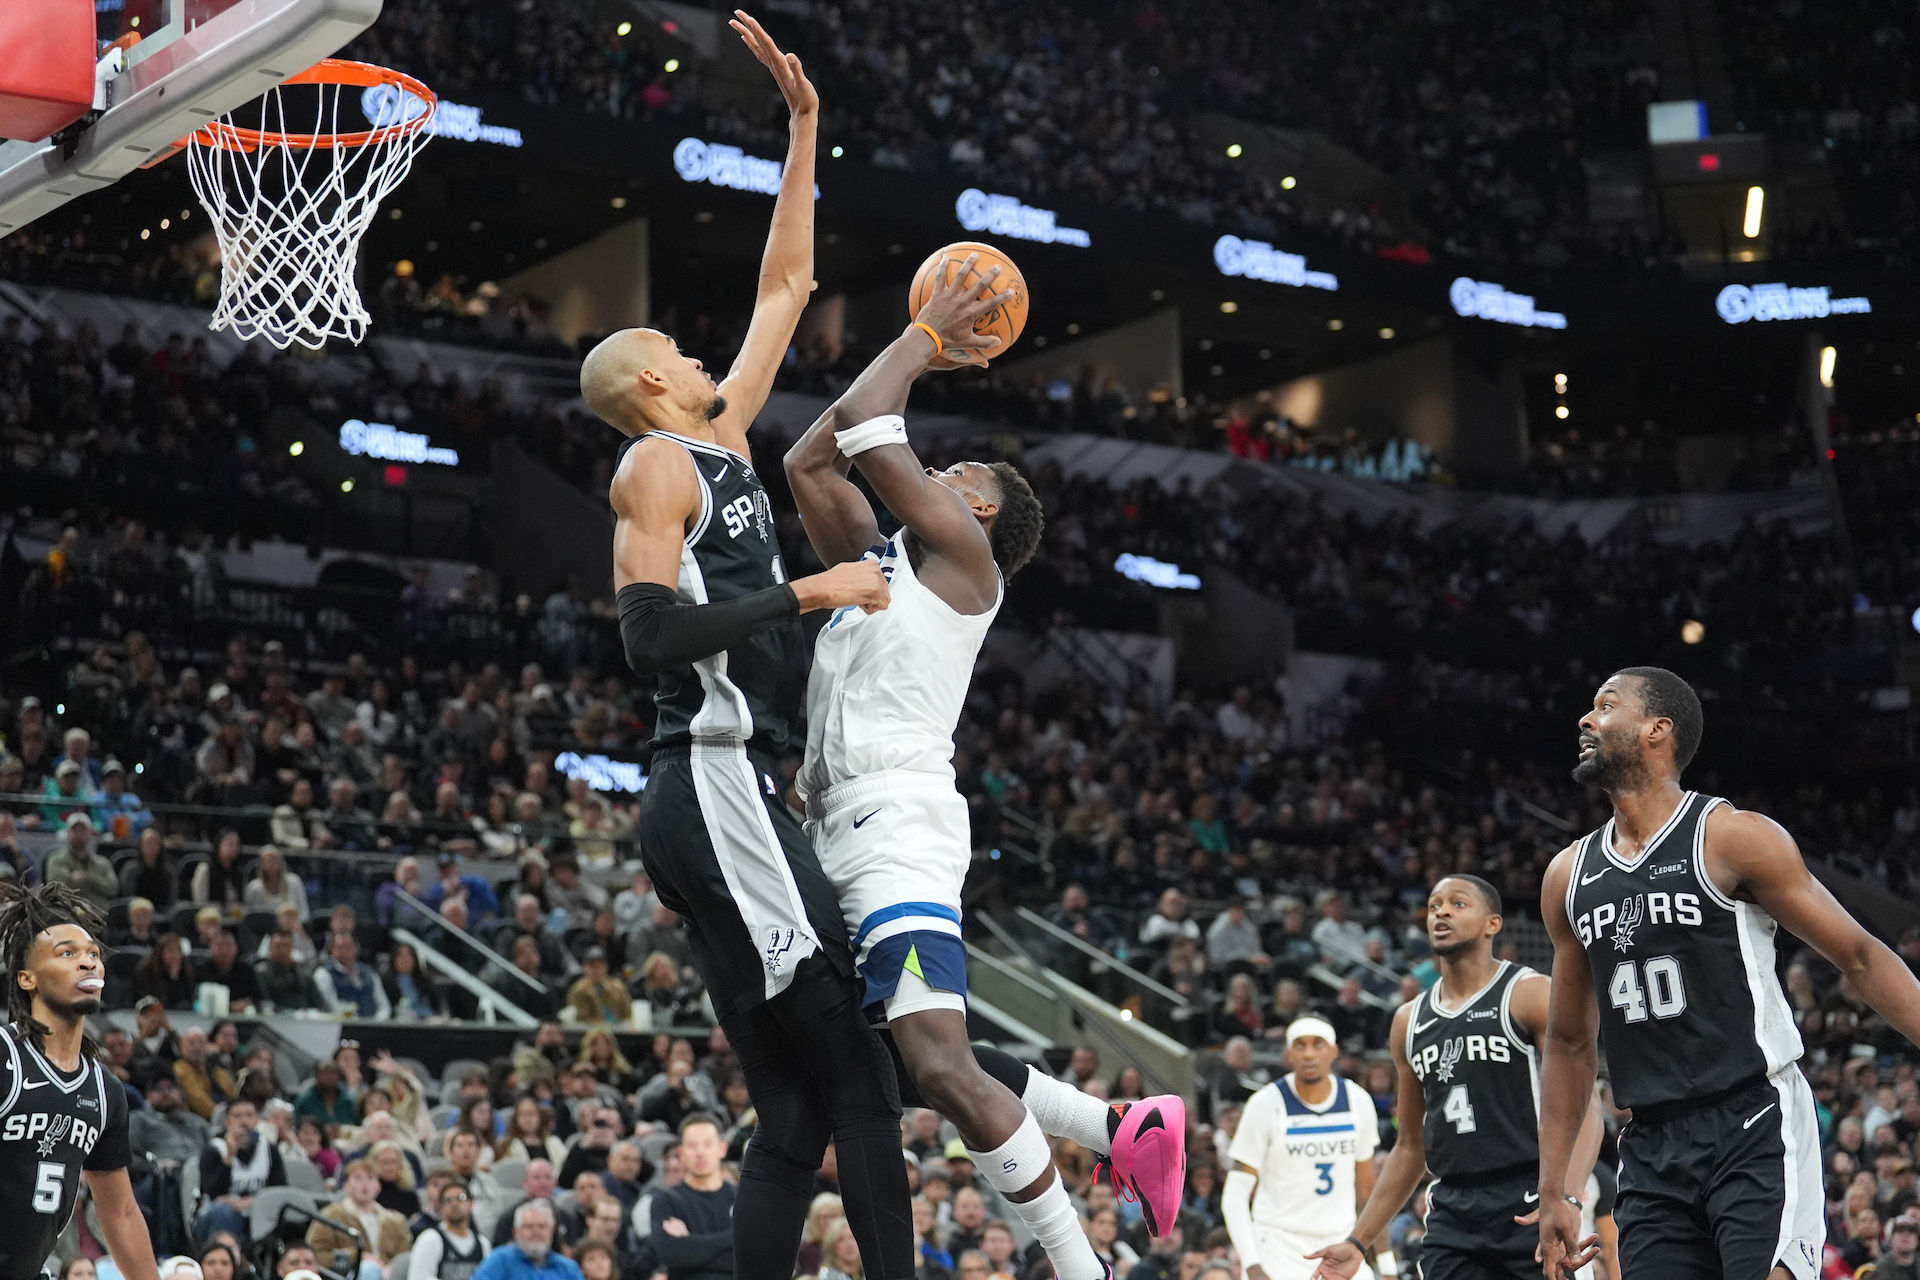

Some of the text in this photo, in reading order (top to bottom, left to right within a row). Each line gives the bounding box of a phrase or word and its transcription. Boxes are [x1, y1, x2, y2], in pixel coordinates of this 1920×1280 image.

[1654, 863, 1682, 875] LEDGER
[1577, 892, 1703, 954] SPURS
[1608, 954, 1687, 1024] 40
[1471, 1010, 1494, 1019] LEDGER
[1411, 1035, 1511, 1083] SPURS
[79, 1098, 97, 1108] LEDGER
[1443, 1084, 1477, 1134] 4
[2, 1112, 99, 1158] SPURS
[32, 1161, 66, 1214] 5
[1315, 1162, 1335, 1196] 3
